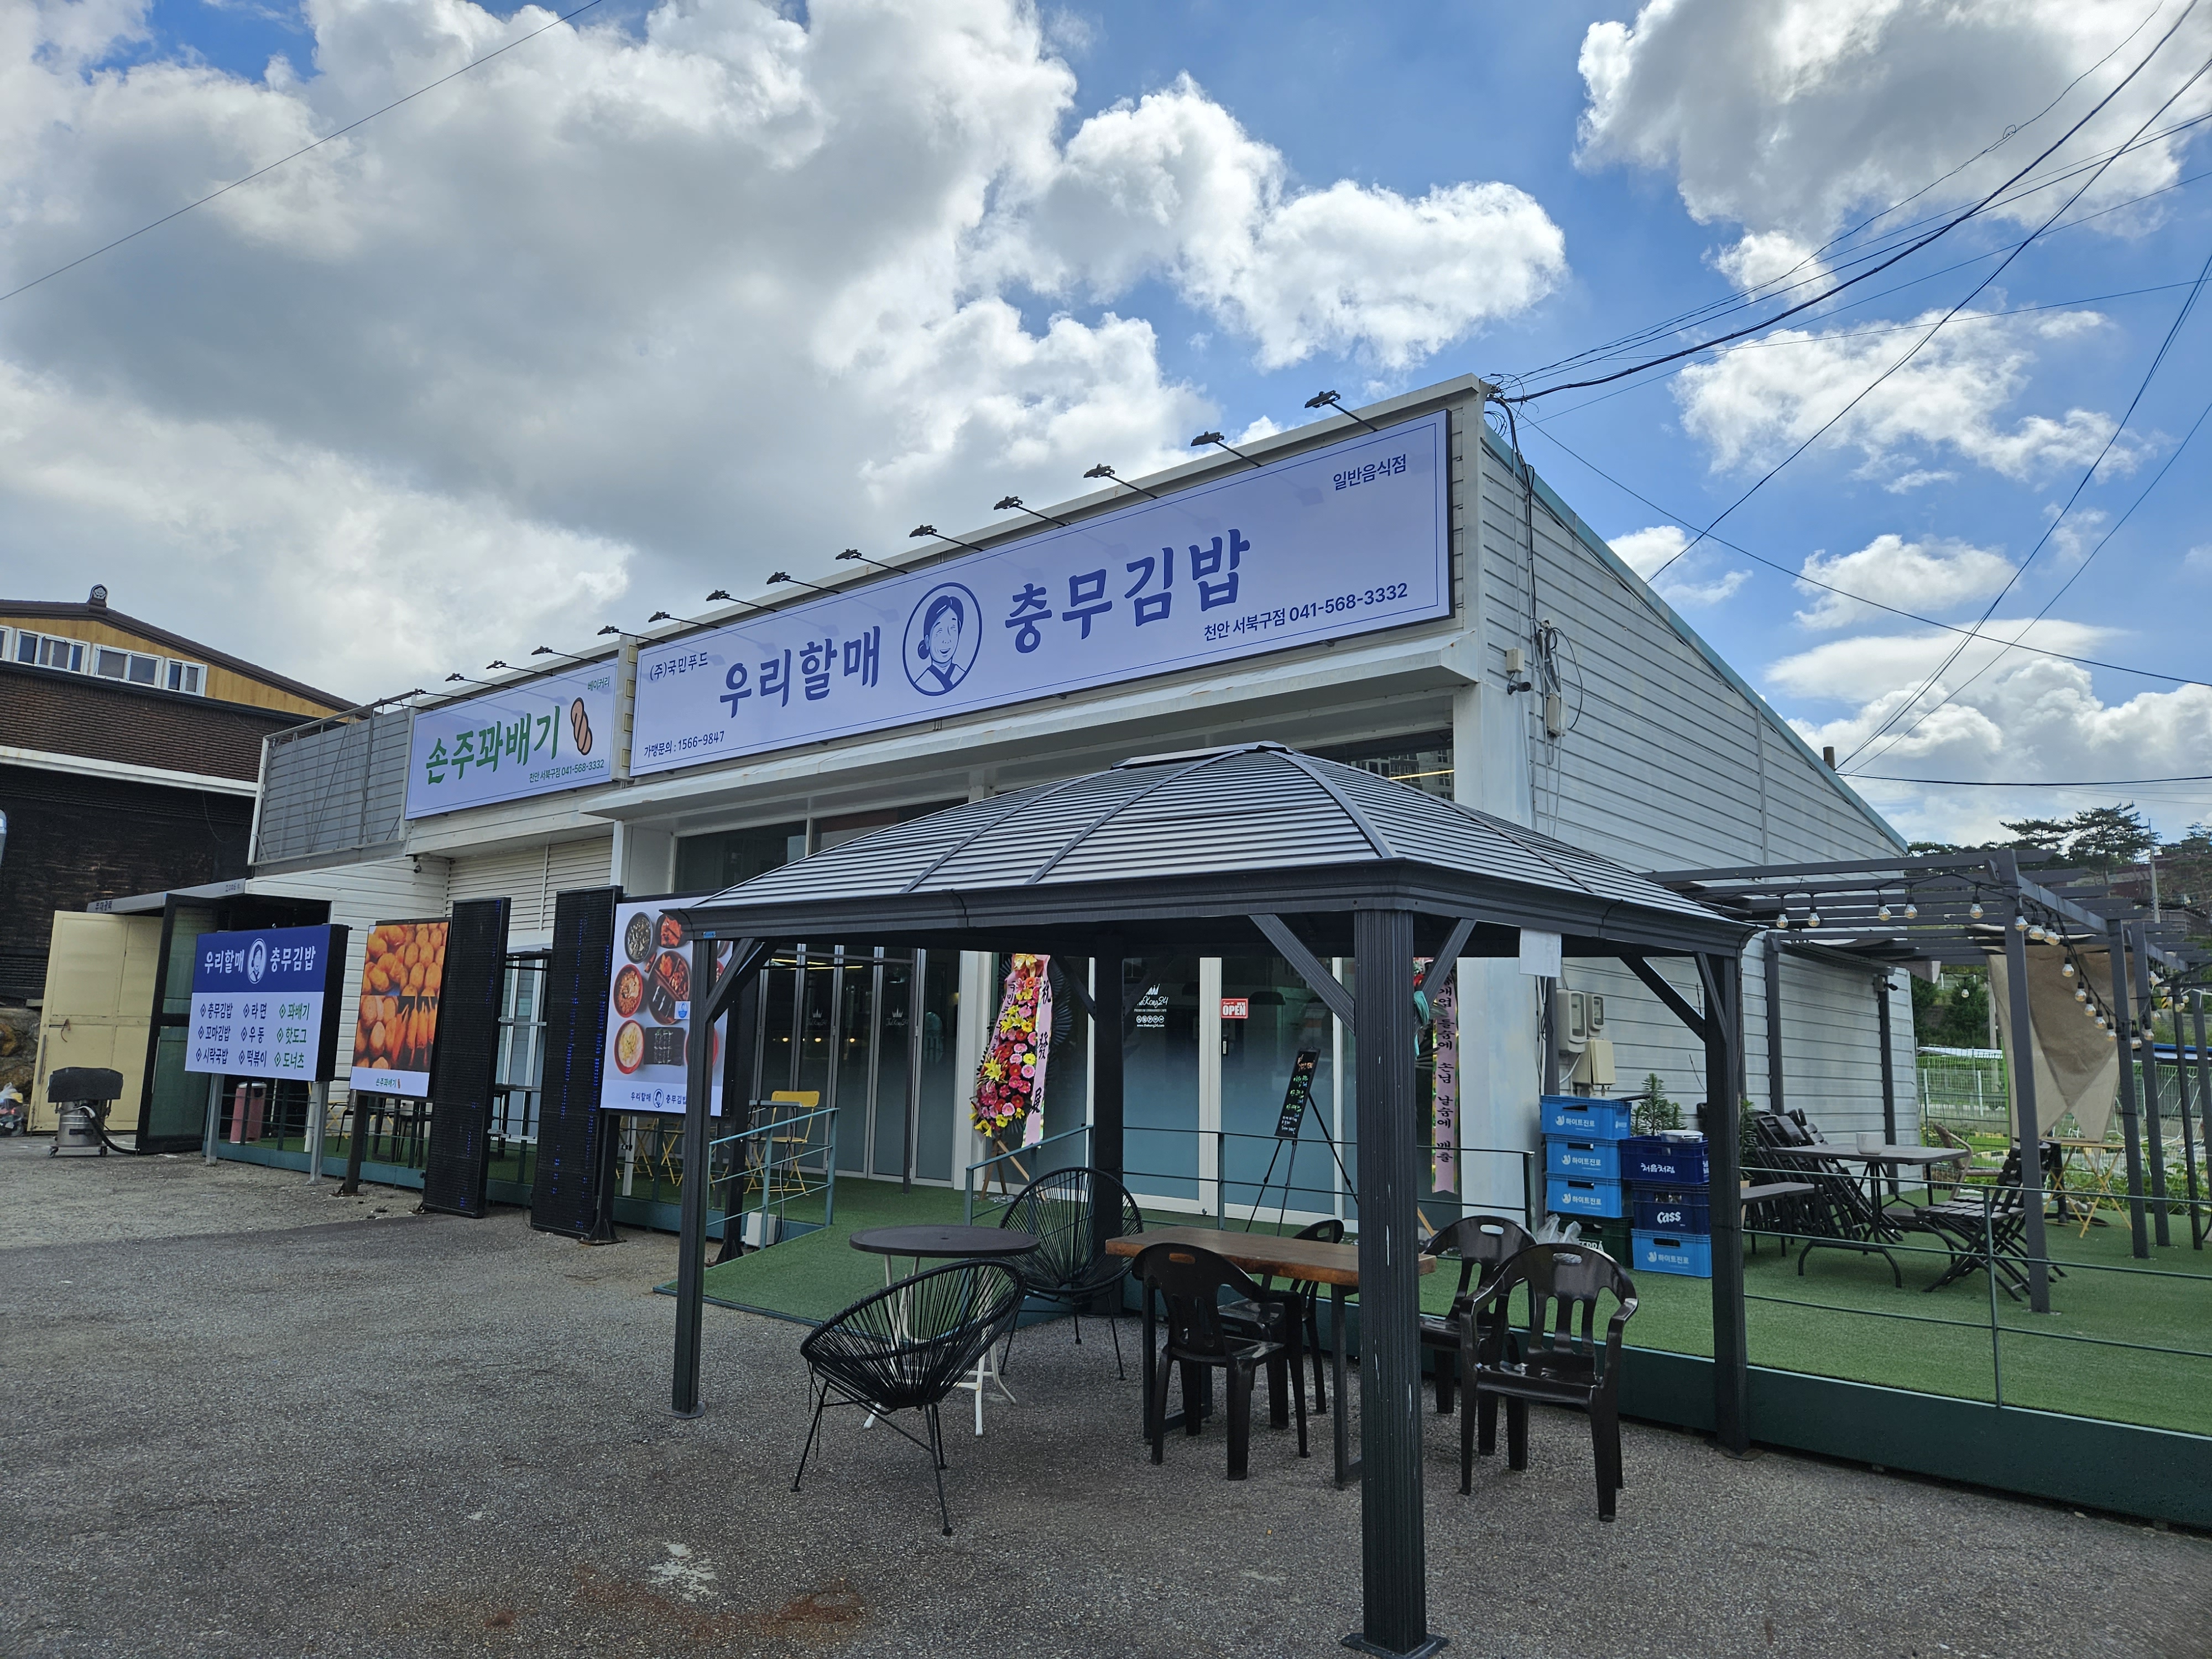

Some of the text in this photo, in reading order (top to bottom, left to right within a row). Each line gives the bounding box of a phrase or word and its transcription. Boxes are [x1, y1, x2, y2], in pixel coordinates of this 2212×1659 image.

[1332, 454, 1407, 491] 일반음식점
[1204, 582, 1408, 641] 천안 서북구점 041-568-3332
[719, 528, 1250, 718] 우리할매 충무김밥
[649, 651, 708, 681] (주)국민푸드
[588, 675, 610, 691] 베이커리
[426, 705, 561, 785] 손주꽈배기
[677, 731, 725, 753] 1566-9847
[529, 759, 604, 784] 천안 서북구점 041-568-3332
[204, 945, 316, 974] 우리할매 충무김밥
[208, 1002, 233, 1019] 충무김밥
[288, 1003, 310, 1020] 꽈배기
[1223, 1005, 1246, 1016] OPEN
[205, 1025, 231, 1042] 꼬마김밥
[285, 1027, 306, 1044] 핫도그
[203, 1047, 228, 1065] 시락국밥
[247, 1050, 267, 1067] 떡볶이
[283, 1051, 304, 1070] 도너츠
[1438, 1062, 1454, 1084] 손님
[376, 1078, 397, 1088] 손주꽈배기
[631, 1092, 651, 1102] 우리할매
[1566, 1117, 1595, 1127] 하이트진로
[1572, 1156, 1601, 1166] 하이트진로
[1640, 1162, 1676, 1174] 처음처럼
[1572, 1196, 1602, 1206] 하이트진로
[1657, 1211, 1681, 1224] Cass
[1657, 1254, 1690, 1265] 하이트진로
